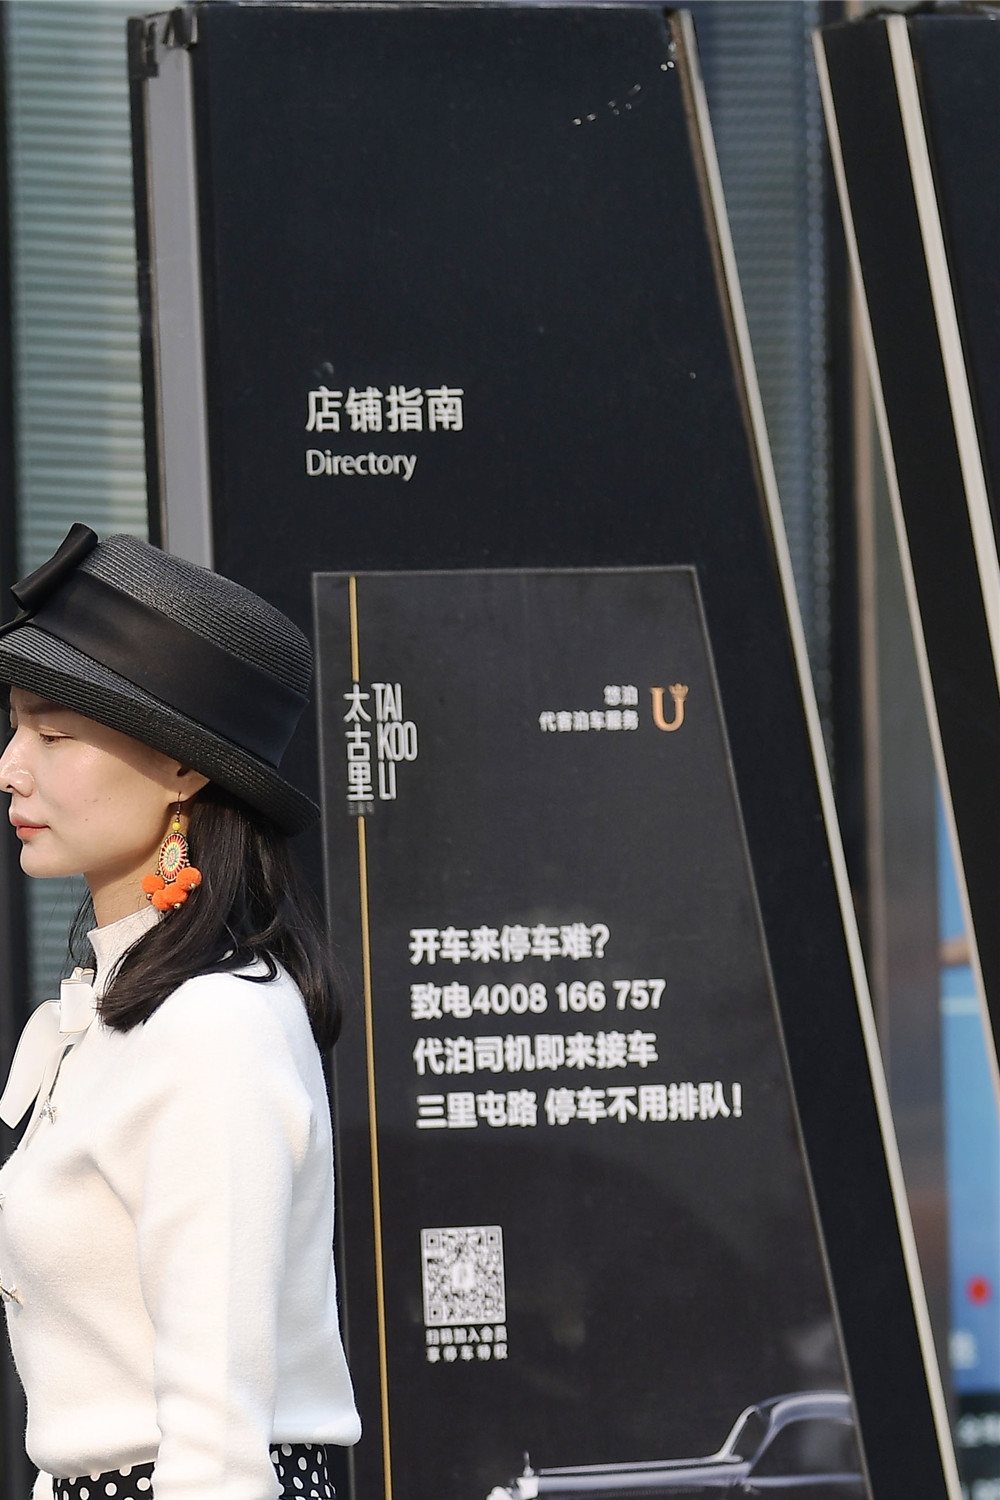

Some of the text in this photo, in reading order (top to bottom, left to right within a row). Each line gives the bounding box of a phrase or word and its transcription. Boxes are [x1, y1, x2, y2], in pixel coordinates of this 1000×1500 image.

[306, 385, 463, 432] 店铺指南
[306, 450, 416, 481] Directory
[371, 683, 402, 722] TAI
[343, 683, 374, 801] 太古里
[377, 721, 417, 761] KOO
[409, 923, 609, 964] 开车来停车难?
[411, 979, 665, 1019] 致电4008 166 757
[413, 1030, 658, 1075] 代泊司机即来接车
[416, 1081, 743, 1128] 三里屯路 停车不用排队!
